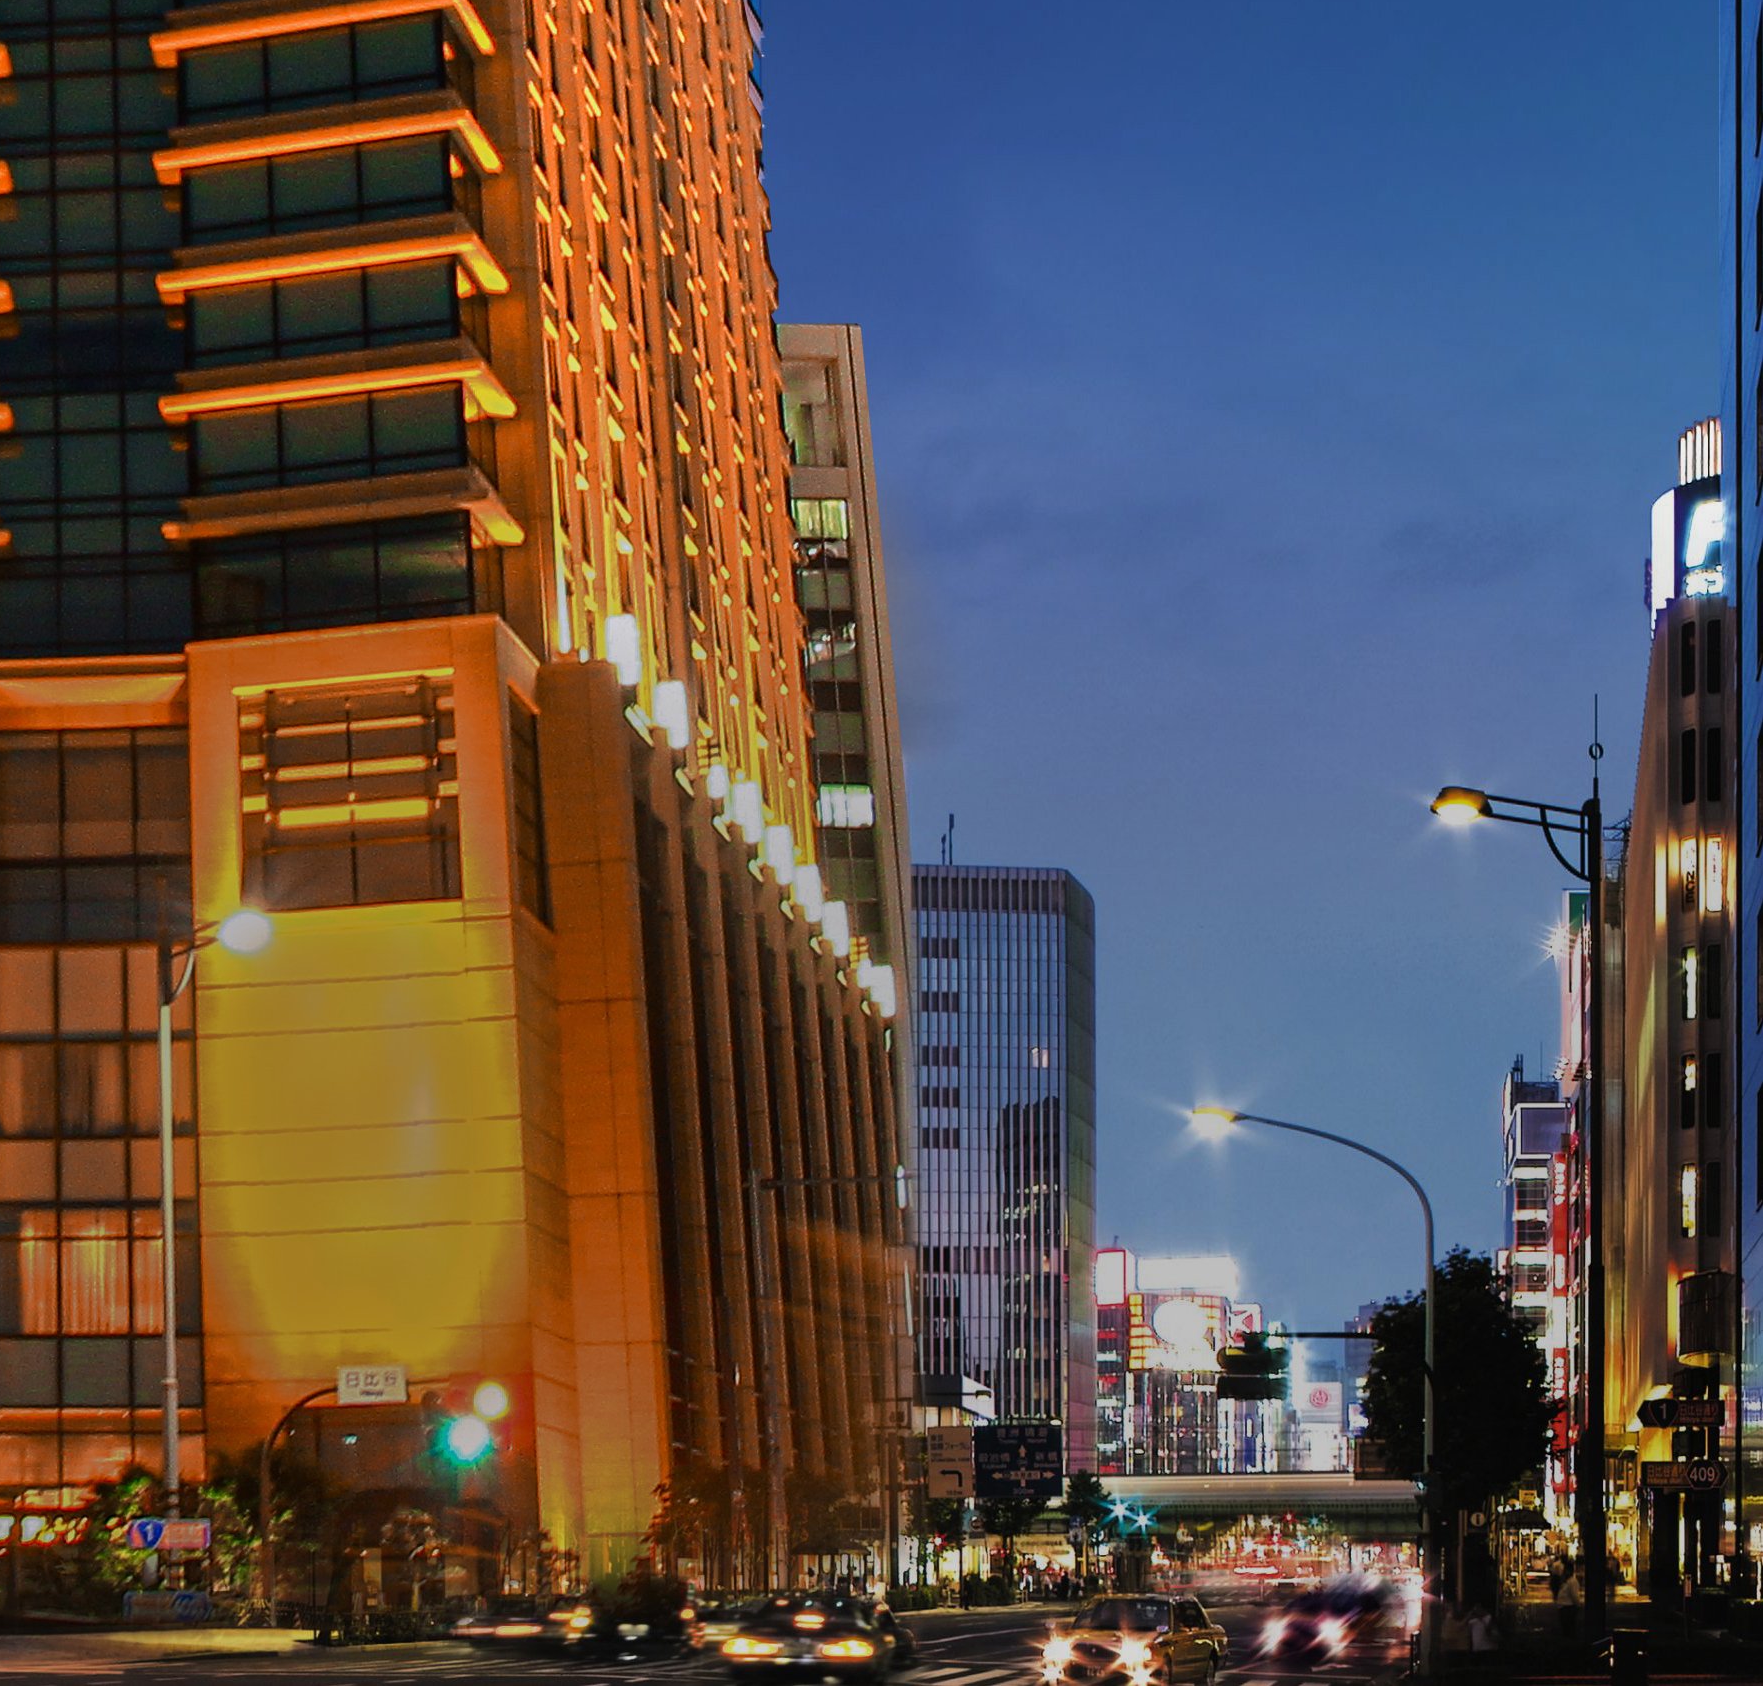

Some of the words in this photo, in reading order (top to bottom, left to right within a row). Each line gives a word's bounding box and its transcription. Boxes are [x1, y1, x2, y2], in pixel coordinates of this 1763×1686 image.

[345, 1370, 397, 1387] 日比谷
[1659, 1403, 1667, 1420] 1
[1689, 1467, 1715, 1481] 409
[145, 1523, 155, 1542] 1
